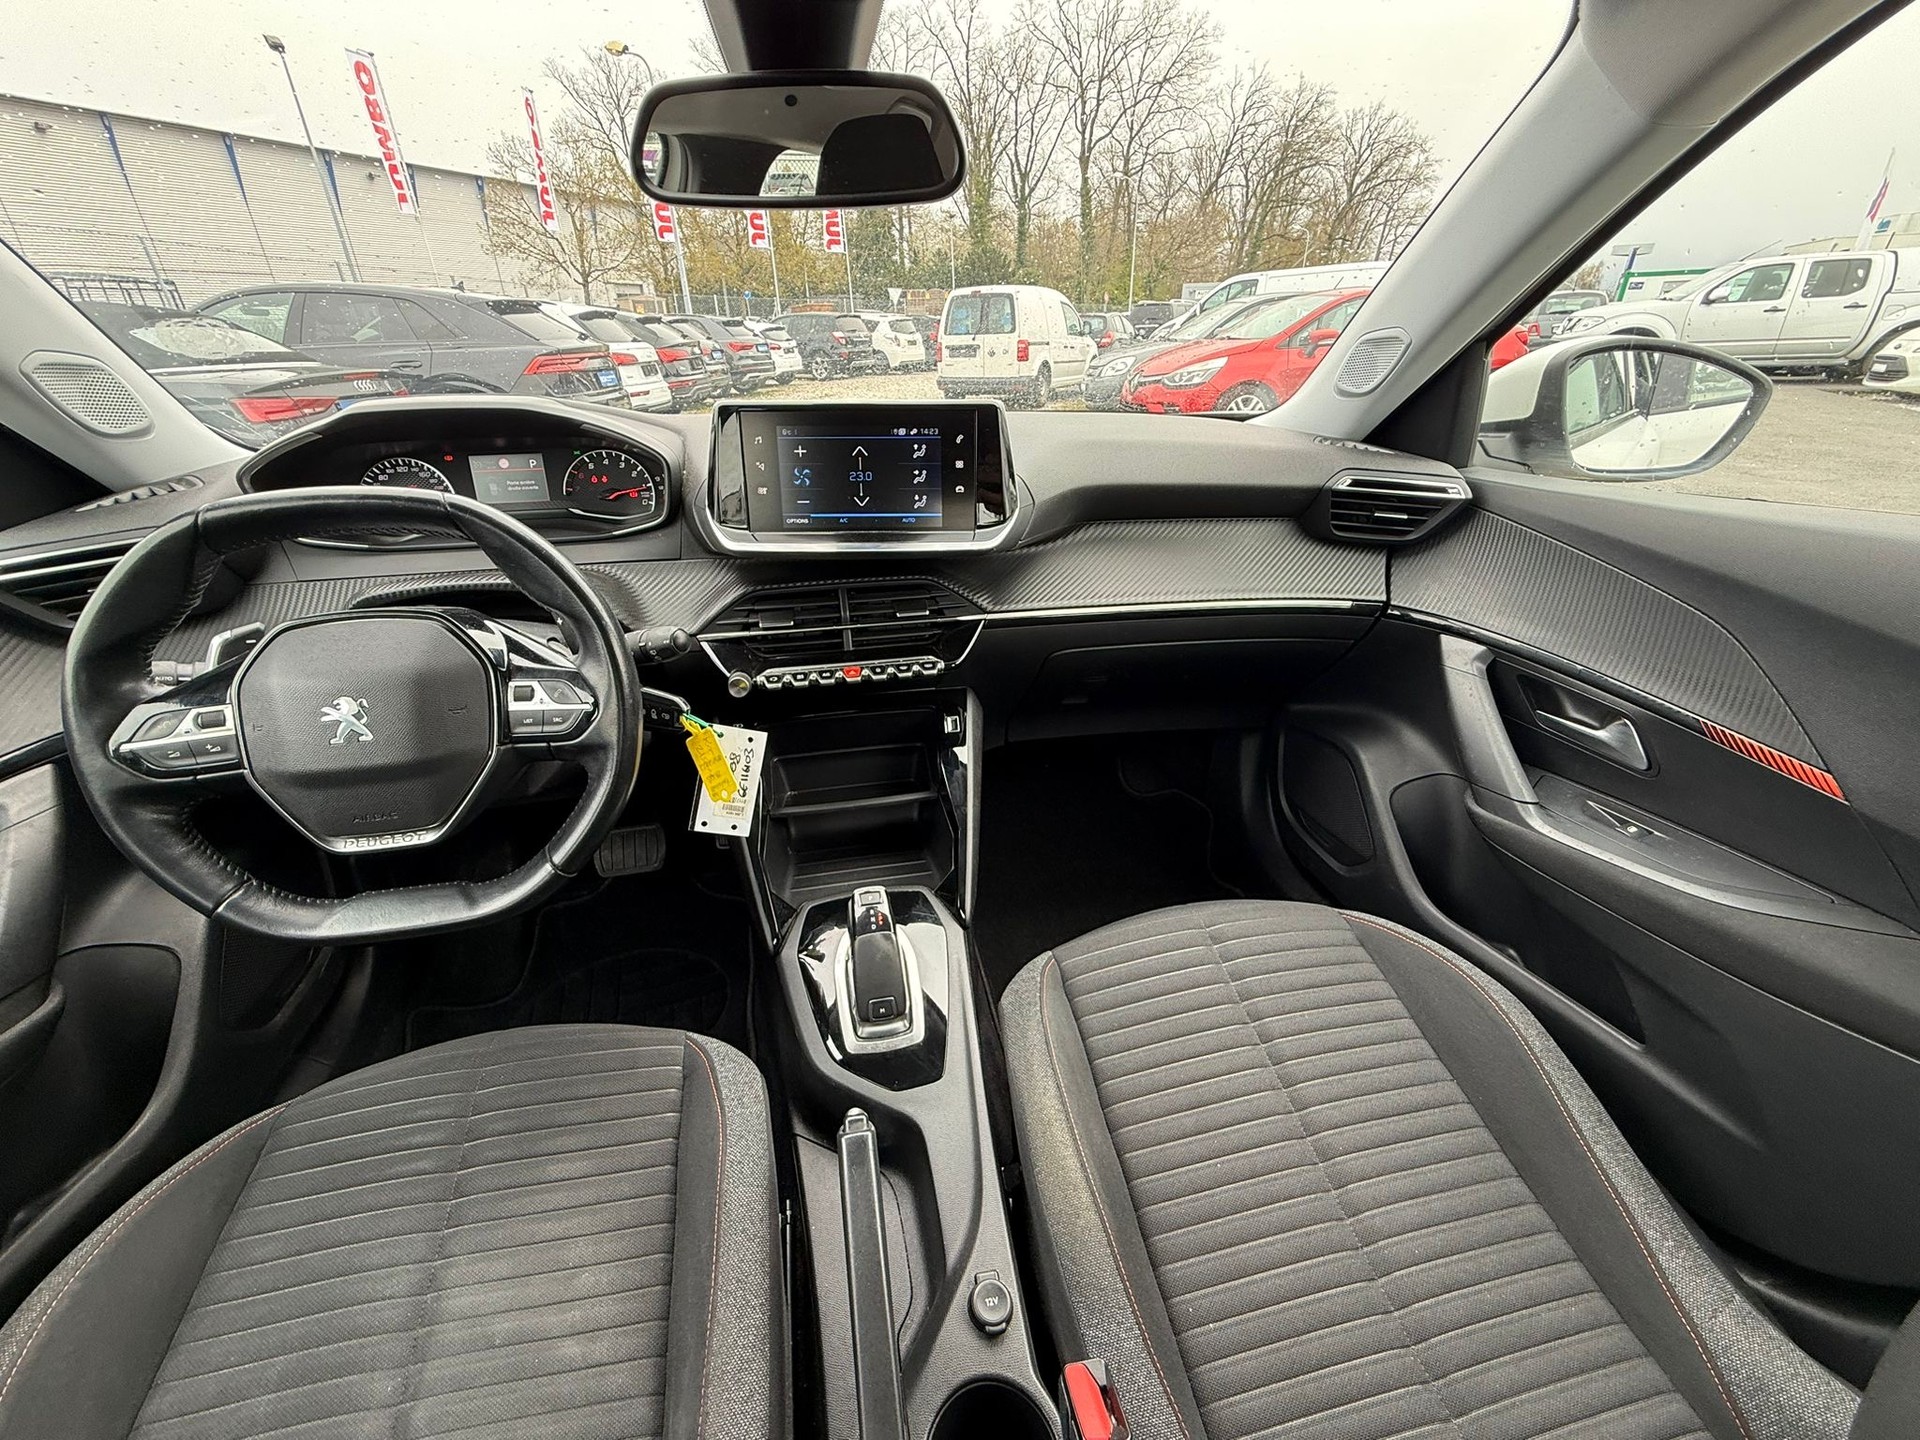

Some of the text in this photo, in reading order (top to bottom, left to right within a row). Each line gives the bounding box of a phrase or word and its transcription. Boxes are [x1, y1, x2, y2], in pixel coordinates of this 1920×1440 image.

[528, 459, 537, 469] P
[849, 471, 873, 482] 23.0
[344, 831, 427, 849] PEUGEOT
[984, 1296, 999, 1307] 12V
